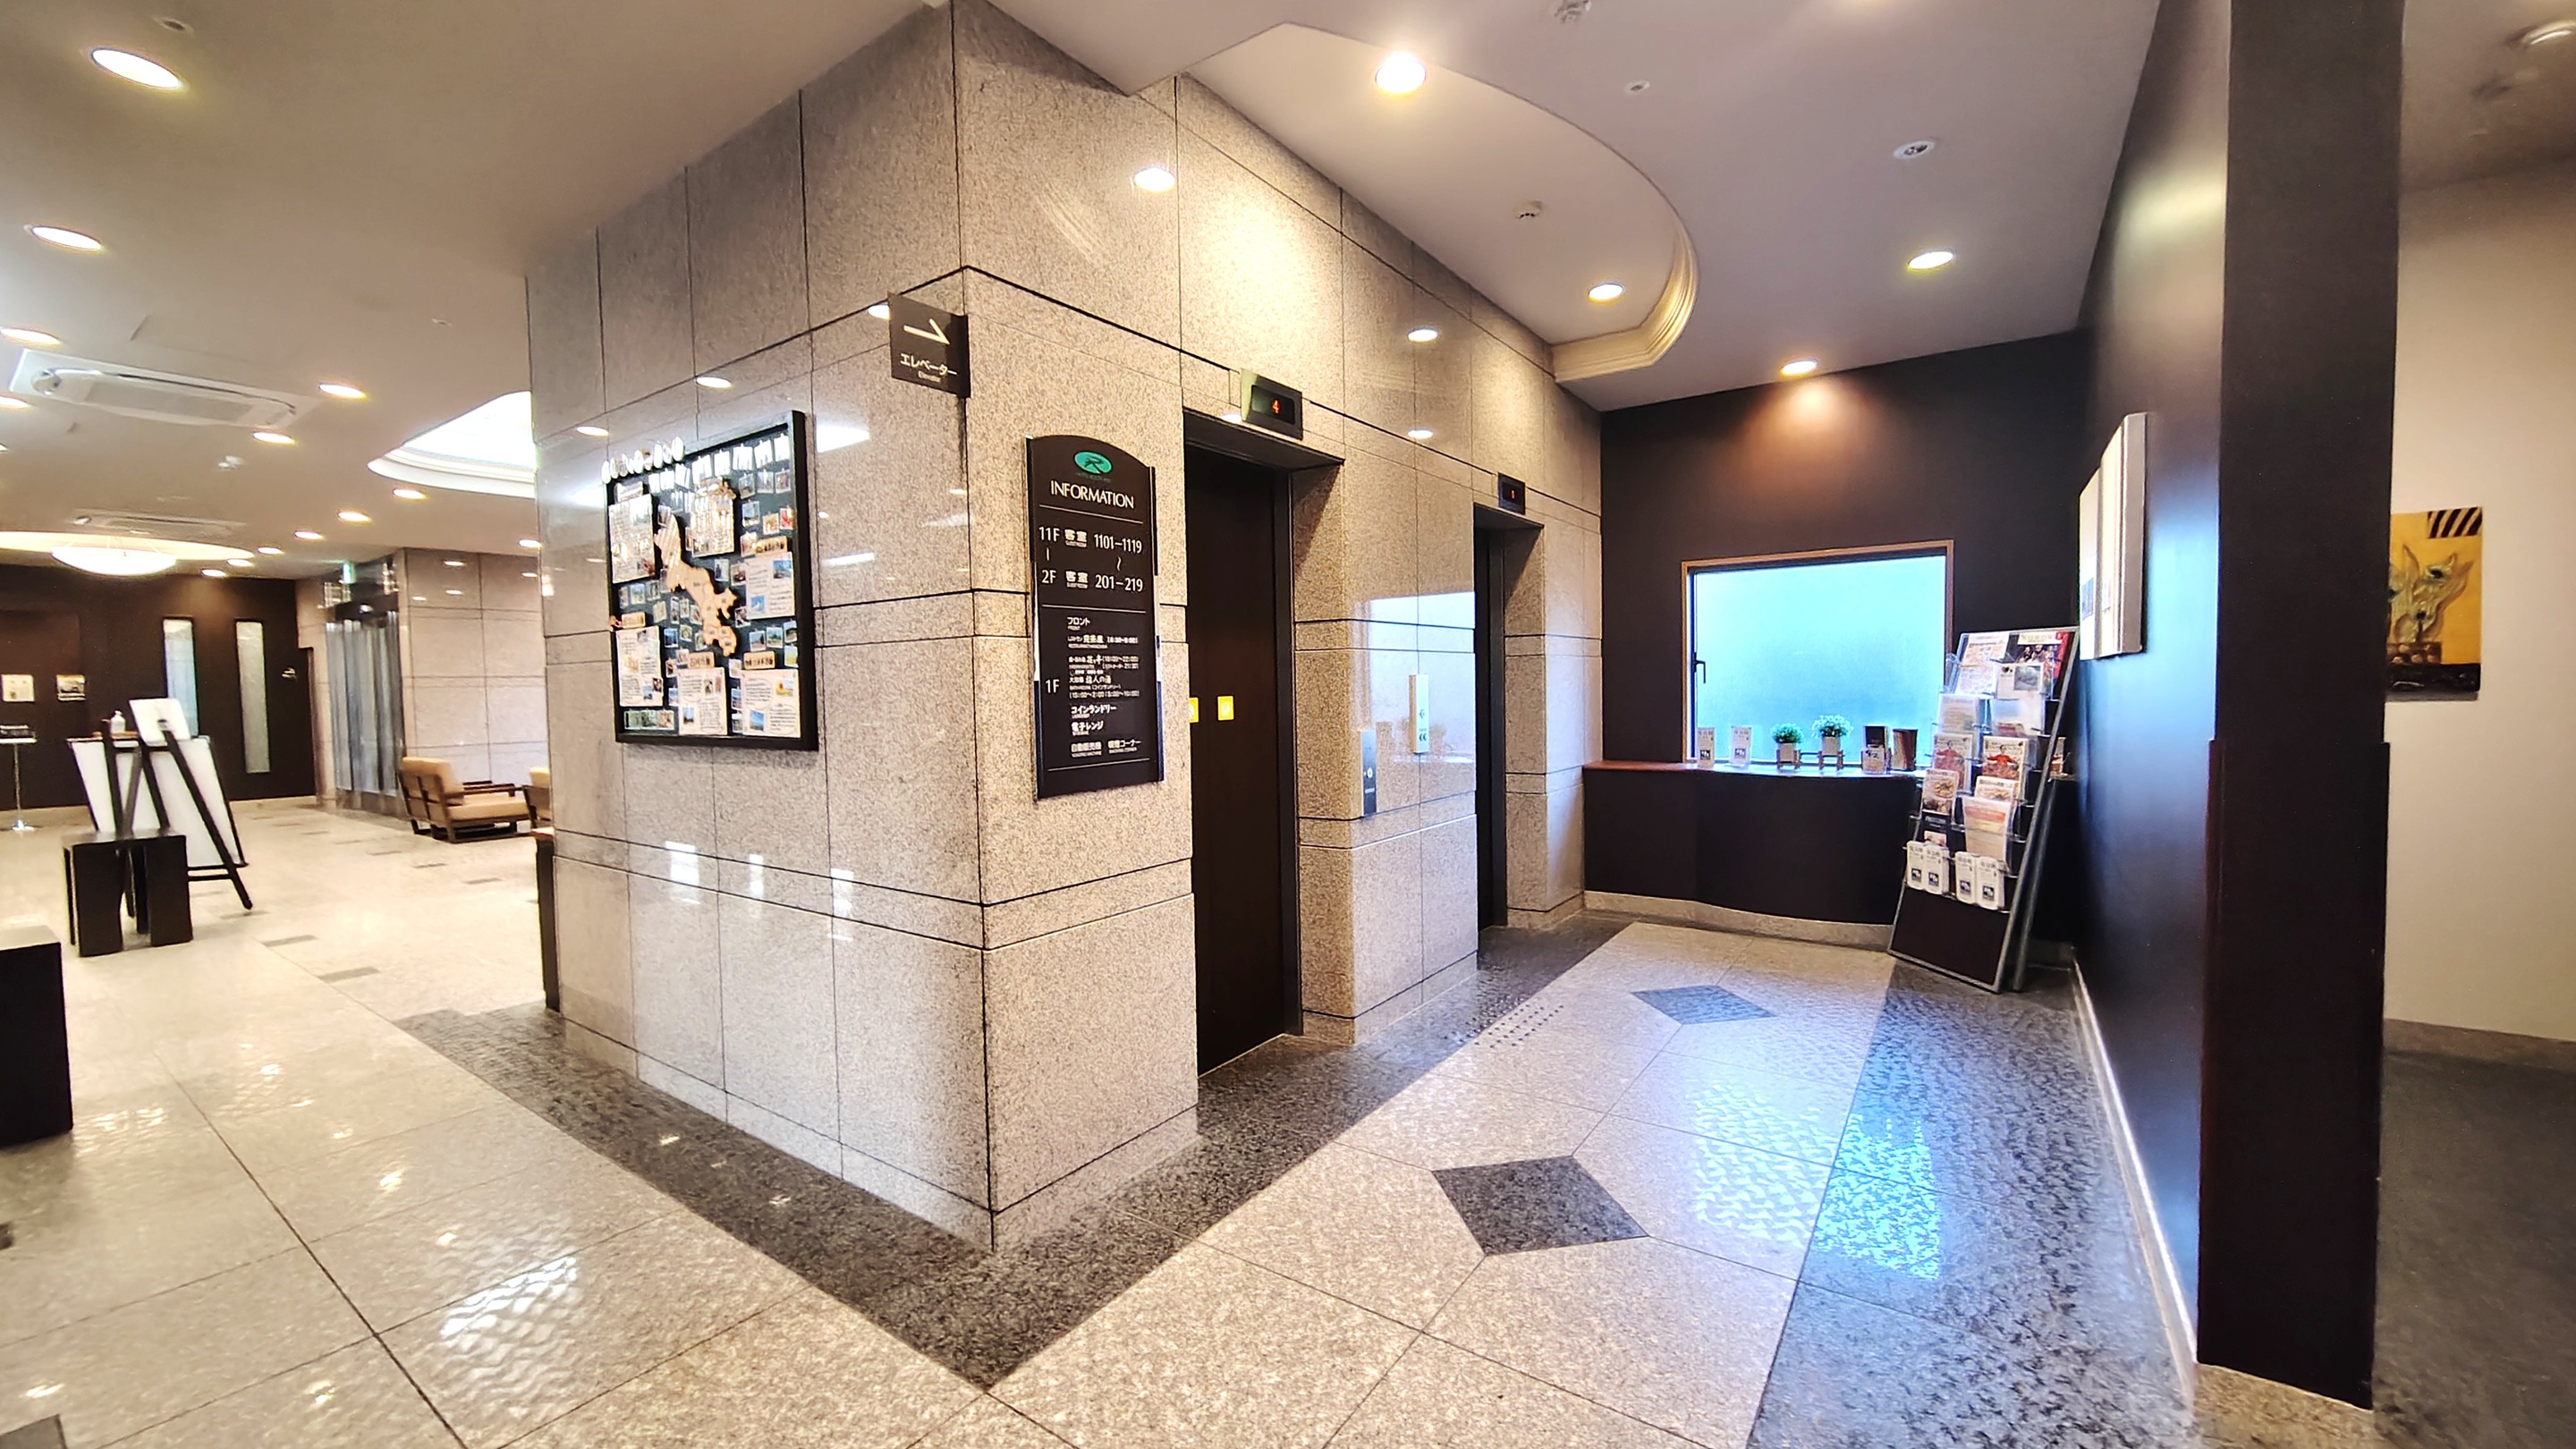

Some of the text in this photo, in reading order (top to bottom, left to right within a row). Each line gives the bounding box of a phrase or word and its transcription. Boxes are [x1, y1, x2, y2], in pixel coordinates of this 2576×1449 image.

[899, 352, 958, 377] エレベーター
[1271, 399, 1280, 414] 4
[1050, 480, 1135, 510] INFORMATION
[1038, 526, 1061, 542] 11F
[1041, 569, 1057, 584] 2F
[1066, 616, 1090, 626] フロント
[1045, 678, 1061, 694] 1F
[1071, 703, 1117, 714] コインランドリー
[1071, 720, 1105, 732] 電子レンジ
